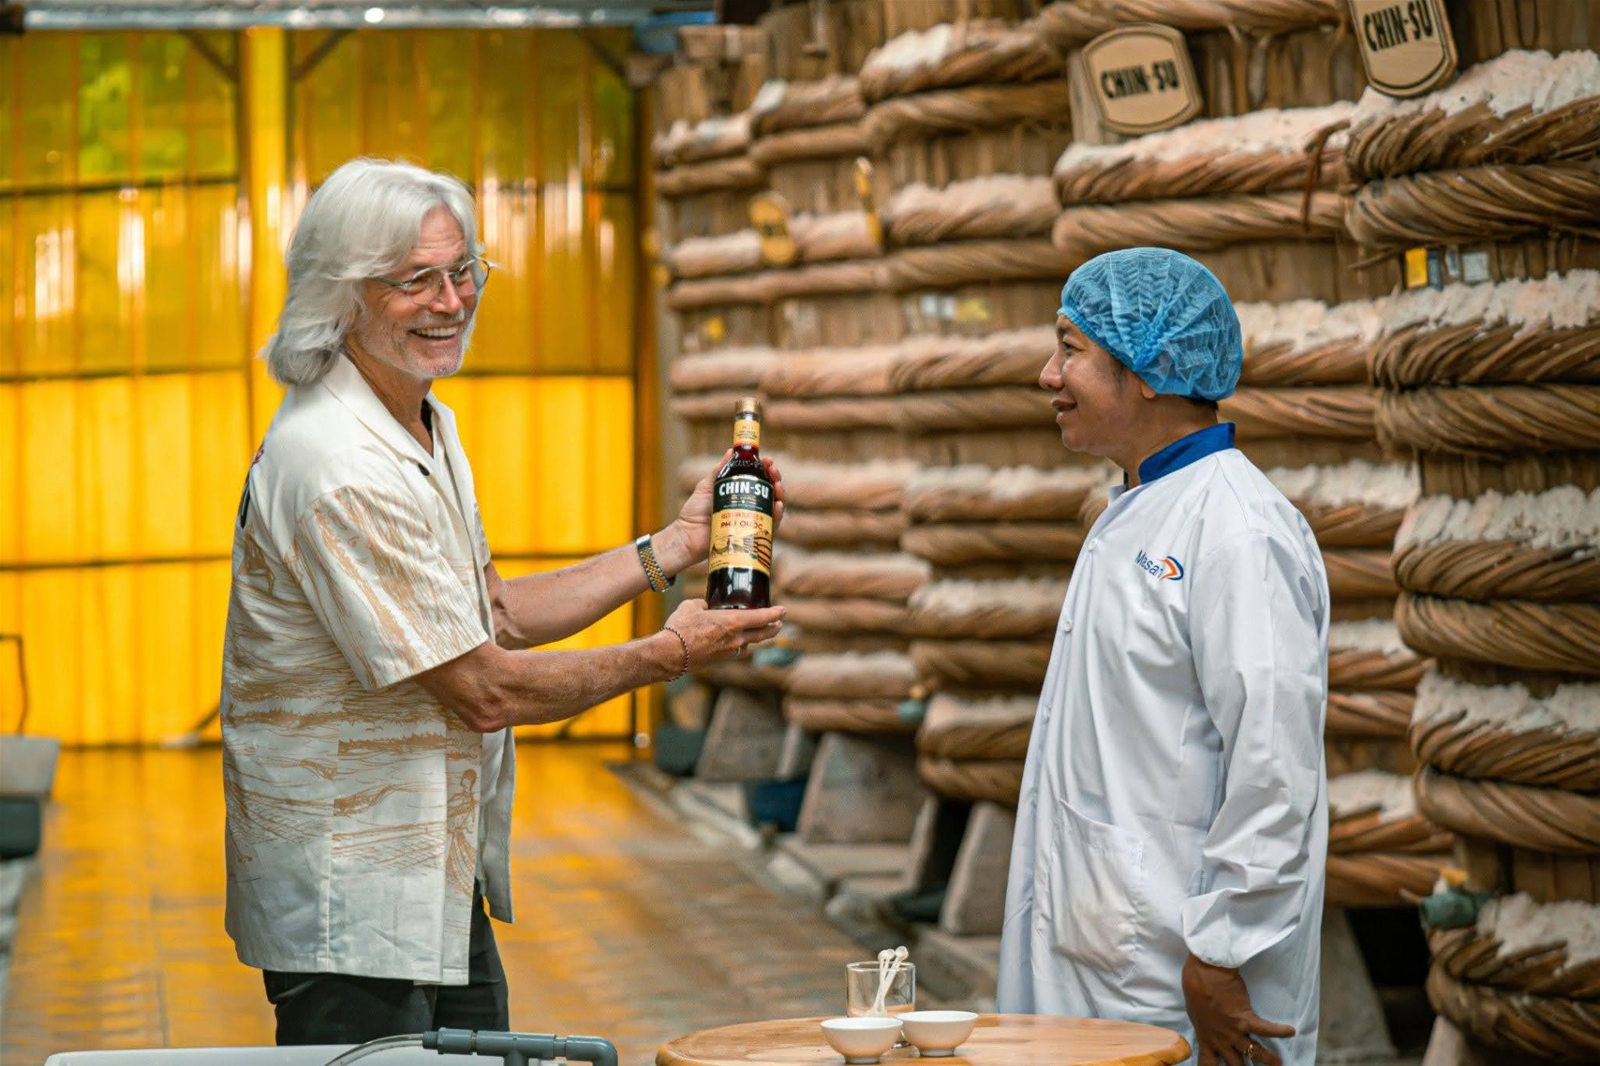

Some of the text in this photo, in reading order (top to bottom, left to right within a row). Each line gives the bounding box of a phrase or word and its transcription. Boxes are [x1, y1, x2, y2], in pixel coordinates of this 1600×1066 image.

[1364, 0, 1433, 52] CHIN-SU
[1101, 61, 1179, 99] CHIN-SU
[718, 481, 769, 499] CHIN-SU
